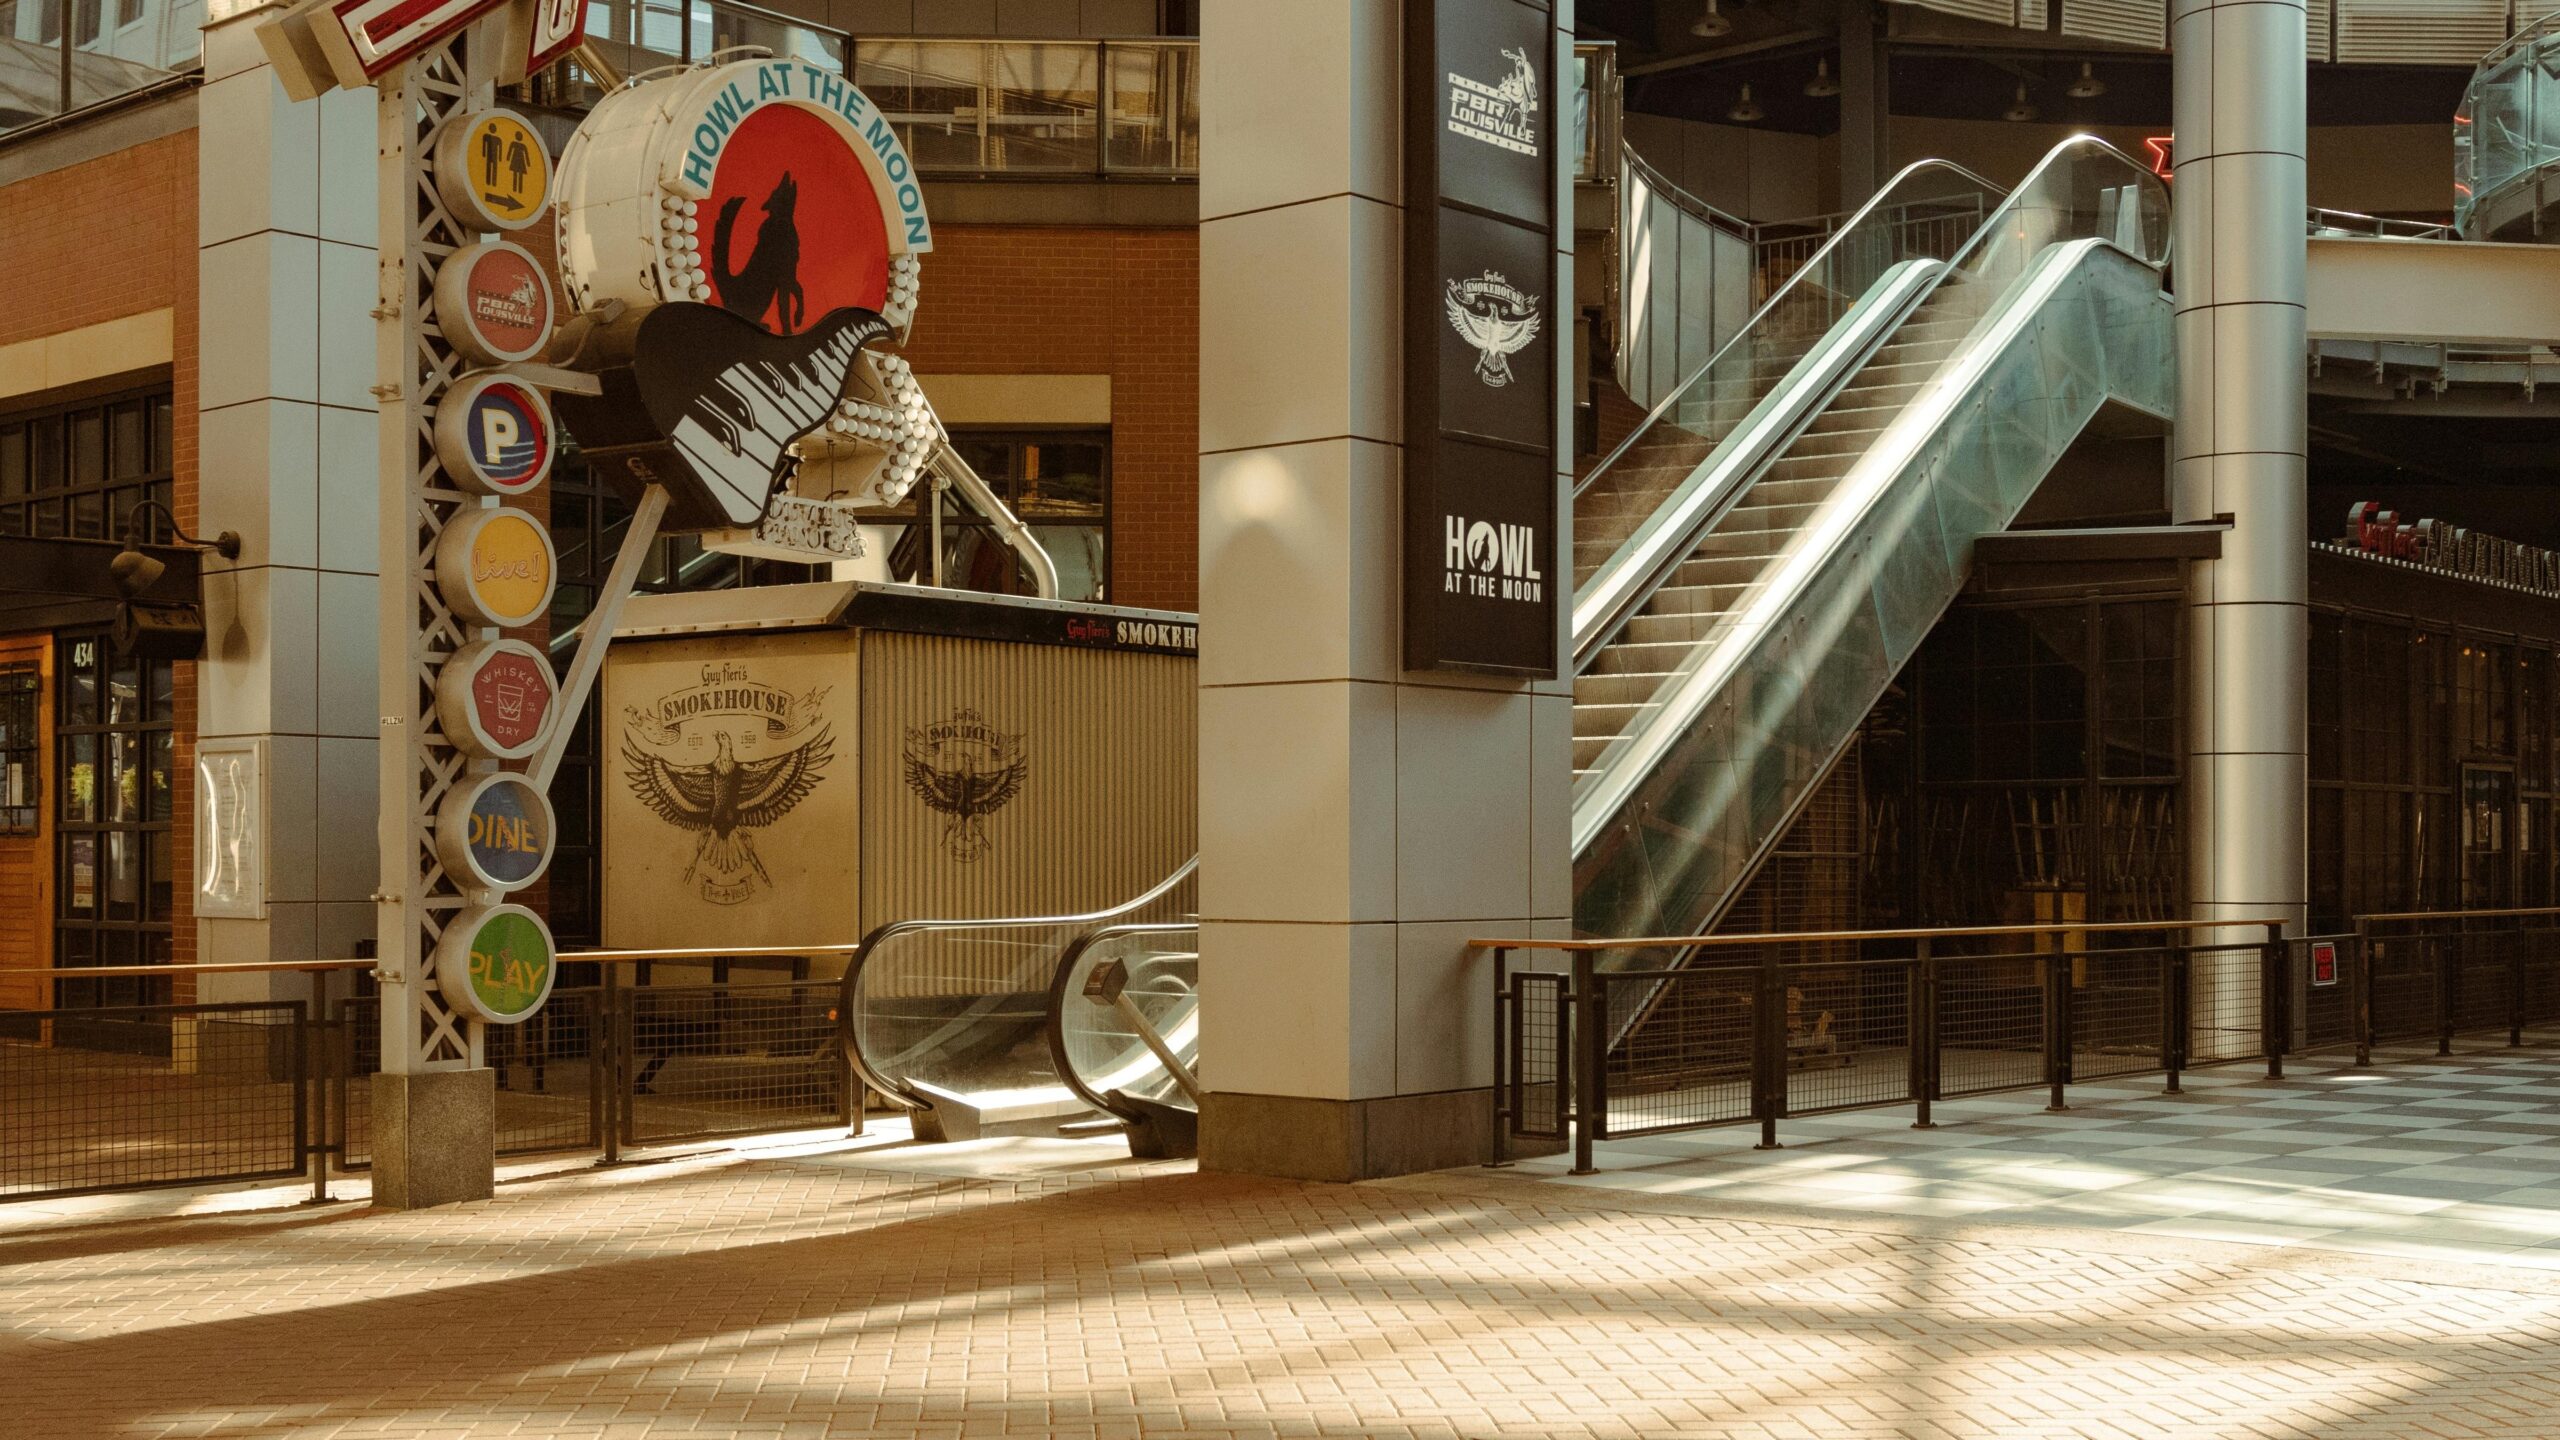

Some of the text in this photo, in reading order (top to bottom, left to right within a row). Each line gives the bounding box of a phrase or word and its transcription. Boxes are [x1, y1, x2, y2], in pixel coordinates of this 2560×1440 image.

[1450, 87, 1506, 118] PBR
[1450, 101, 1536, 144] LOUISVILLE
[684, 63, 928, 245] HOWL AT THE MOON
[477, 296, 516, 312] PBR
[1465, 281, 1523, 304] SMOKEHOUSE
[477, 305, 536, 325] LOUISVILLE
[482, 407, 519, 464] P
[1446, 514, 1541, 580] HOWL
[473, 550, 541, 582] Live!
[1445, 571, 1541, 603] AT THE MOON
[1117, 620, 1199, 649] SMOKEH
[74, 642, 94, 668] 434
[481, 667, 541, 694] WHISKEY
[701, 664, 721, 687] Guy
[663, 689, 787, 722] SMOKEHOUSE
[498, 725, 519, 737] DRY
[468, 812, 539, 853] DINE
[469, 951, 545, 993] PLAY
